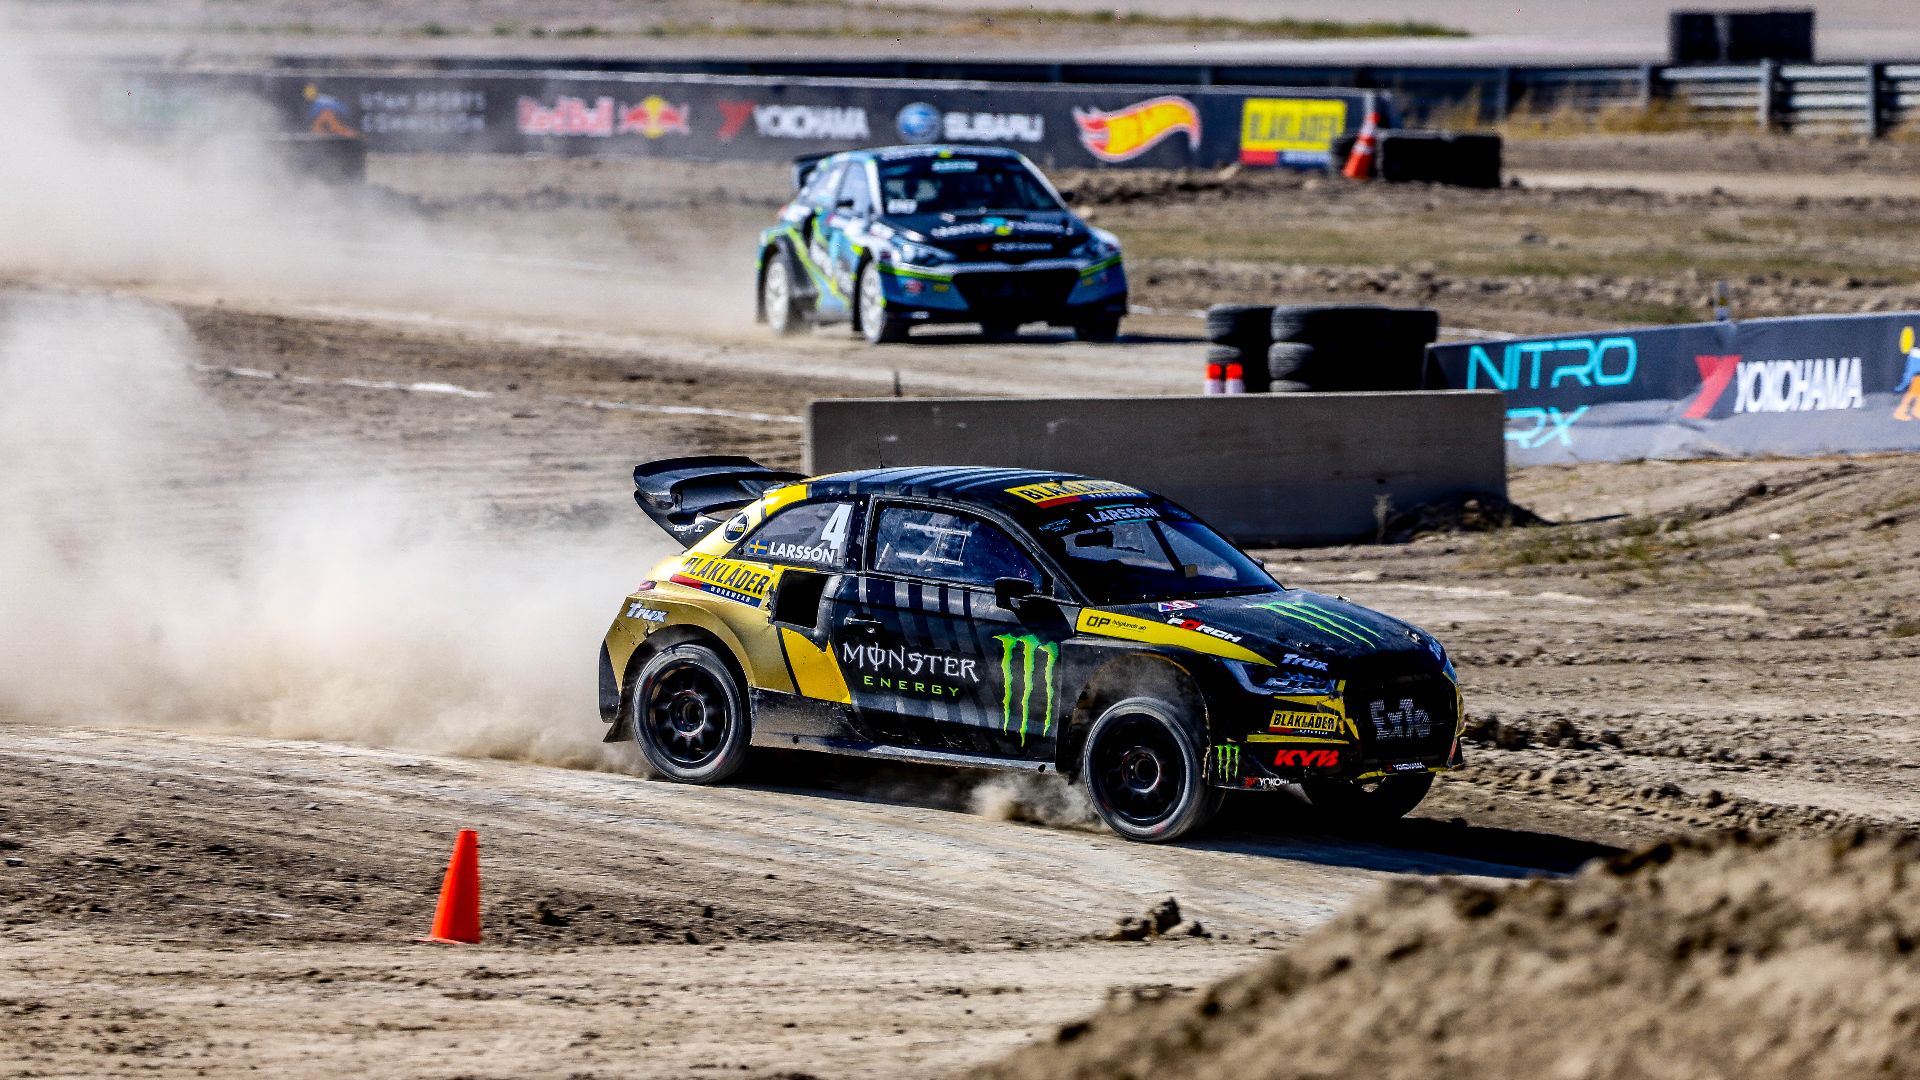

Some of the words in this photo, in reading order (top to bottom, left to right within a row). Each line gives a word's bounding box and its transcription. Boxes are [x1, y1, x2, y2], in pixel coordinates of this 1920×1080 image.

[944, 111, 1044, 142] SUBARU
[1467, 337, 1638, 390] NITRO
[1734, 357, 1863, 413] YOKOHAMA
[1504, 404, 1590, 449] RX
[821, 504, 853, 549] 4
[1086, 507, 1160, 523] LARSSON
[769, 542, 835, 563] LARSSON
[681, 556, 770, 595] BLÅKLÄDER
[626, 602, 669, 622] Trux
[842, 642, 980, 683] MONSTER
[1281, 653, 1328, 671] Trux
[863, 675, 960, 696] ENERGY
[1274, 750, 1339, 766] KYB
